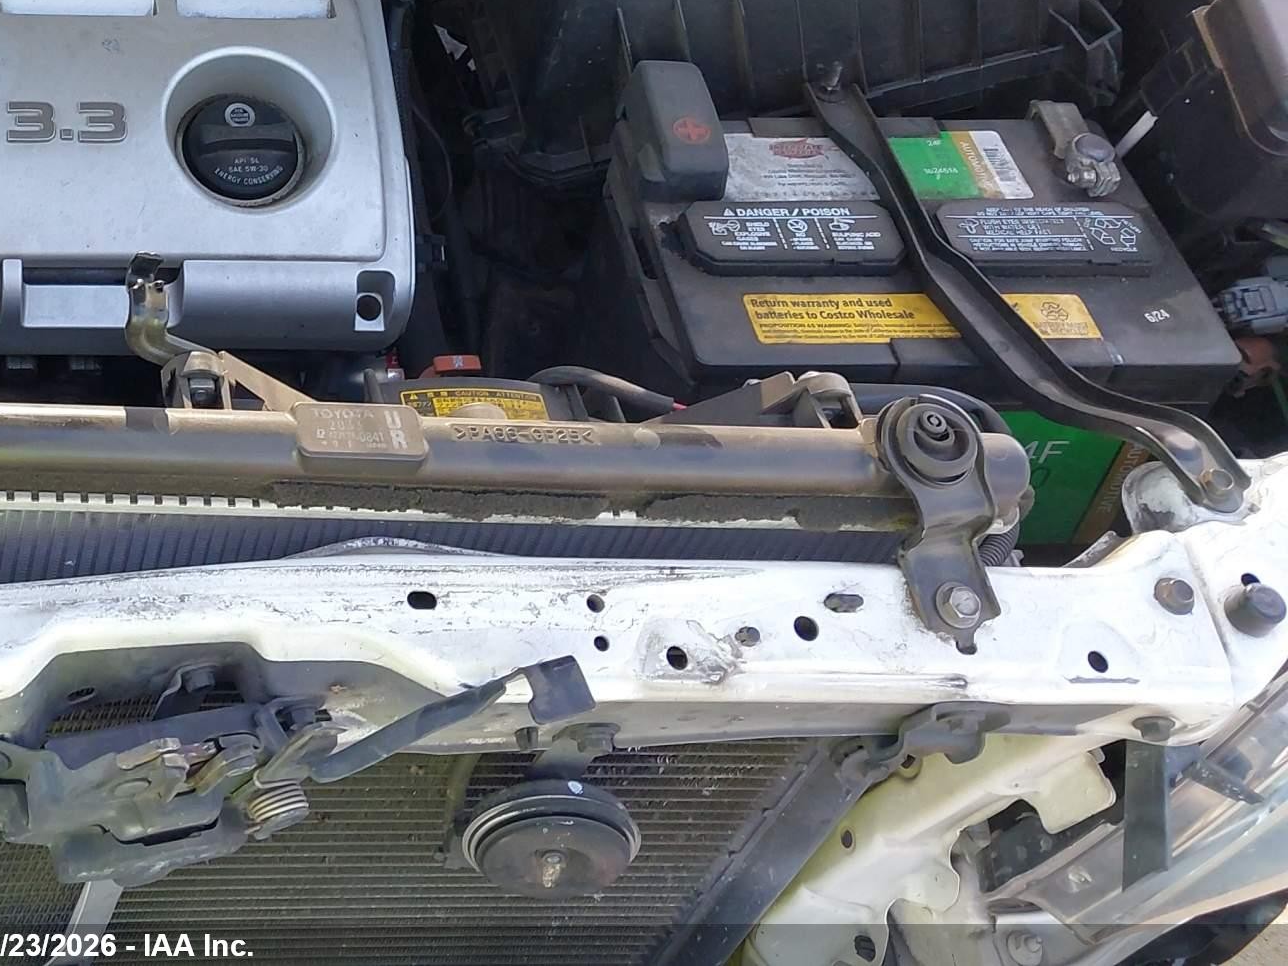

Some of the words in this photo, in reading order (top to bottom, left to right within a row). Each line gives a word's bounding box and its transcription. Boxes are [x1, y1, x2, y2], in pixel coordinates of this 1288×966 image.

[5, 100, 128, 145] 3.3
[736, 208, 789, 217] DANGER
[802, 208, 850, 216] POISON
[751, 299, 789, 308] Return
[791, 299, 840, 310] warranty
[842, 299, 862, 307] and
[865, 299, 892, 307] used
[756, 311, 805, 320] batteries
[806, 312, 818, 320] to
[819, 311, 855, 320] Costco
[857, 310, 916, 320] Wholesale
[1144, 308, 1170, 323] 6/24
[311, 407, 376, 420] TOYOTA
